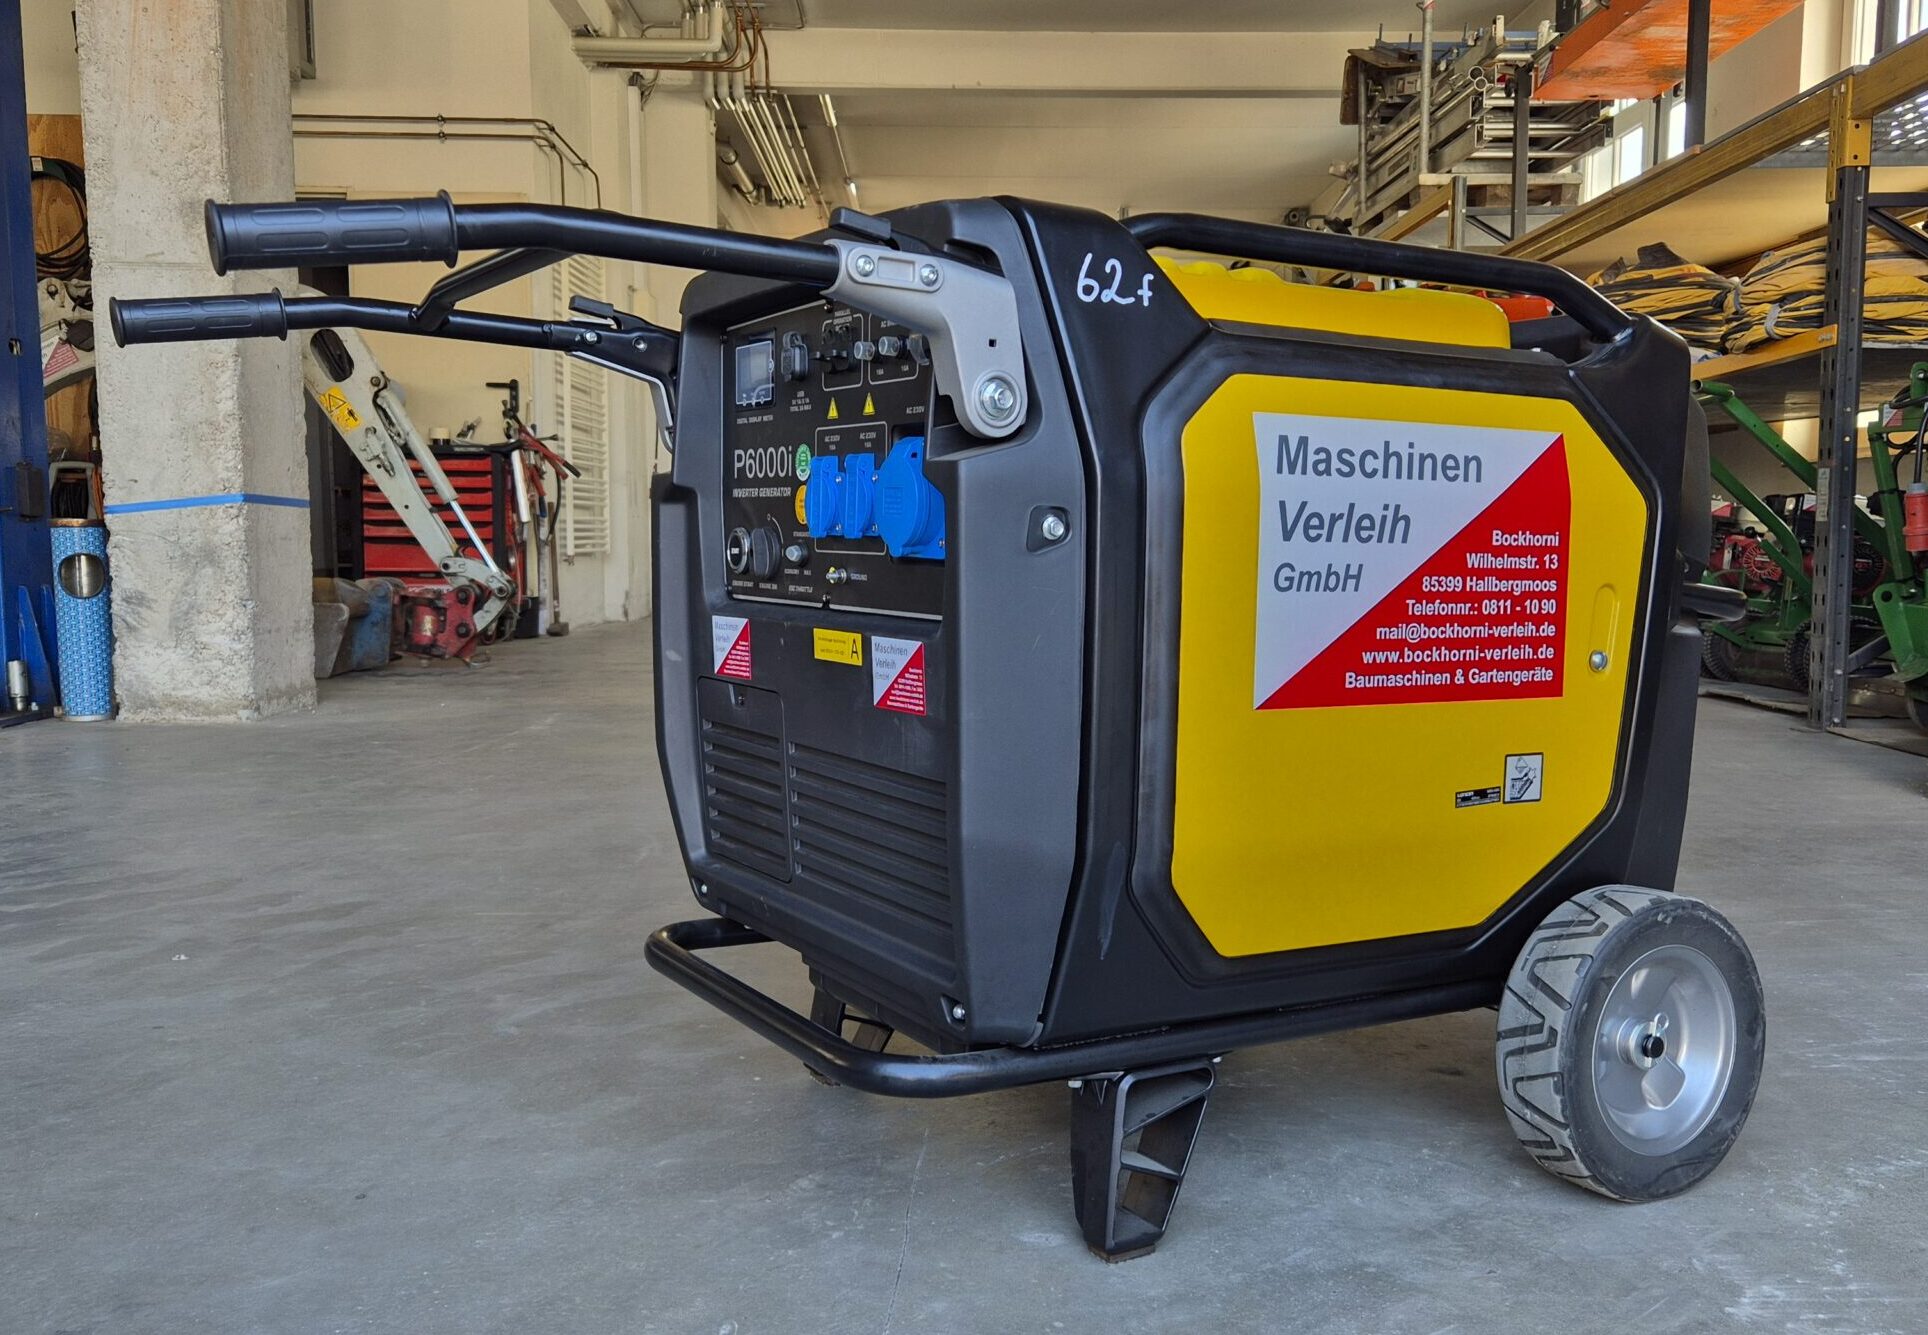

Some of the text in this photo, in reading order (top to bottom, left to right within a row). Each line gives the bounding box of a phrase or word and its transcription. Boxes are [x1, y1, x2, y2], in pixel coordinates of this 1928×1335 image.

[734, 445, 792, 479] P6000i
[1276, 434, 1482, 483] Maschinen
[732, 487, 792, 498] INVERTER GENERATOR
[1278, 500, 1411, 544] Verleih
[1492, 530, 1560, 547] Bockhorni
[1466, 552, 1559, 569] Wilhelmstr. 13
[1273, 562, 1364, 593] GmbH
[1422, 576, 1557, 595] 85399 Hallbergmoos
[1406, 599, 1478, 615] Telefonnr.:
[1482, 599, 1512, 615] 0811
[1376, 621, 1556, 643] mail@bockhorni-verleih.de
[851, 638, 859, 661] A
[874, 642, 908, 656] Maschinen
[1361, 644, 1554, 664] www.bockhorni-verleih.de
[875, 657, 897, 669] Verleih
[1345, 667, 1554, 688] Baumaschinen & Gartengeräte
